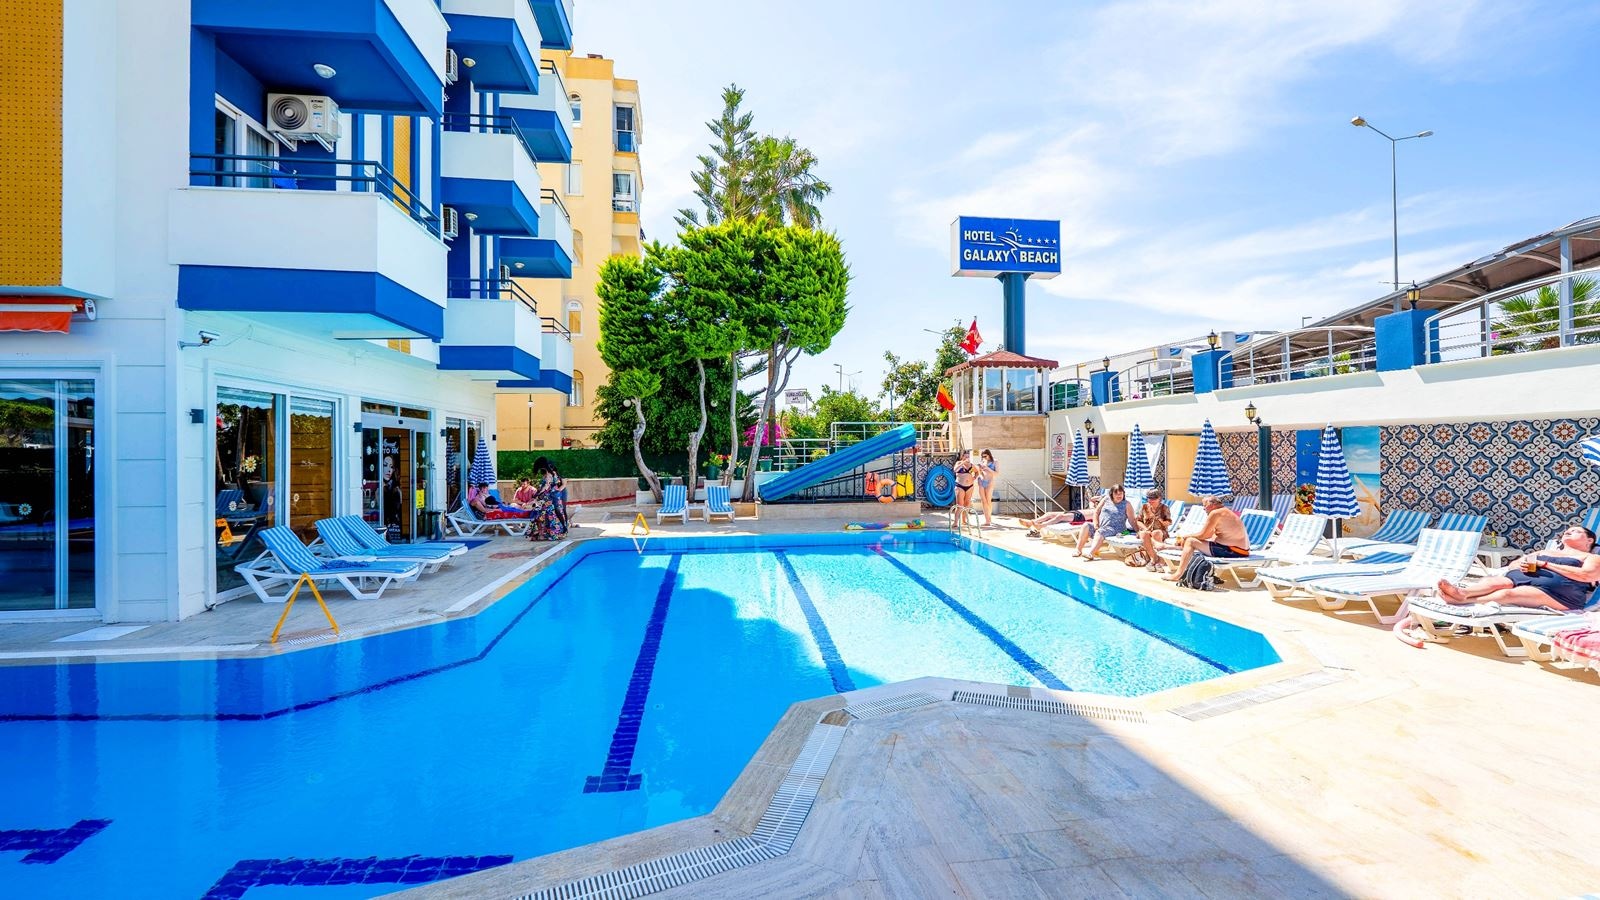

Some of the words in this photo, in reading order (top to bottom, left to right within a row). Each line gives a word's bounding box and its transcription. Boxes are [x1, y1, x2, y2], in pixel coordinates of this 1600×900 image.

[964, 230, 996, 242] HOTEL
[964, 249, 1010, 262] GALAXY
[1020, 250, 1058, 264] BEACH
